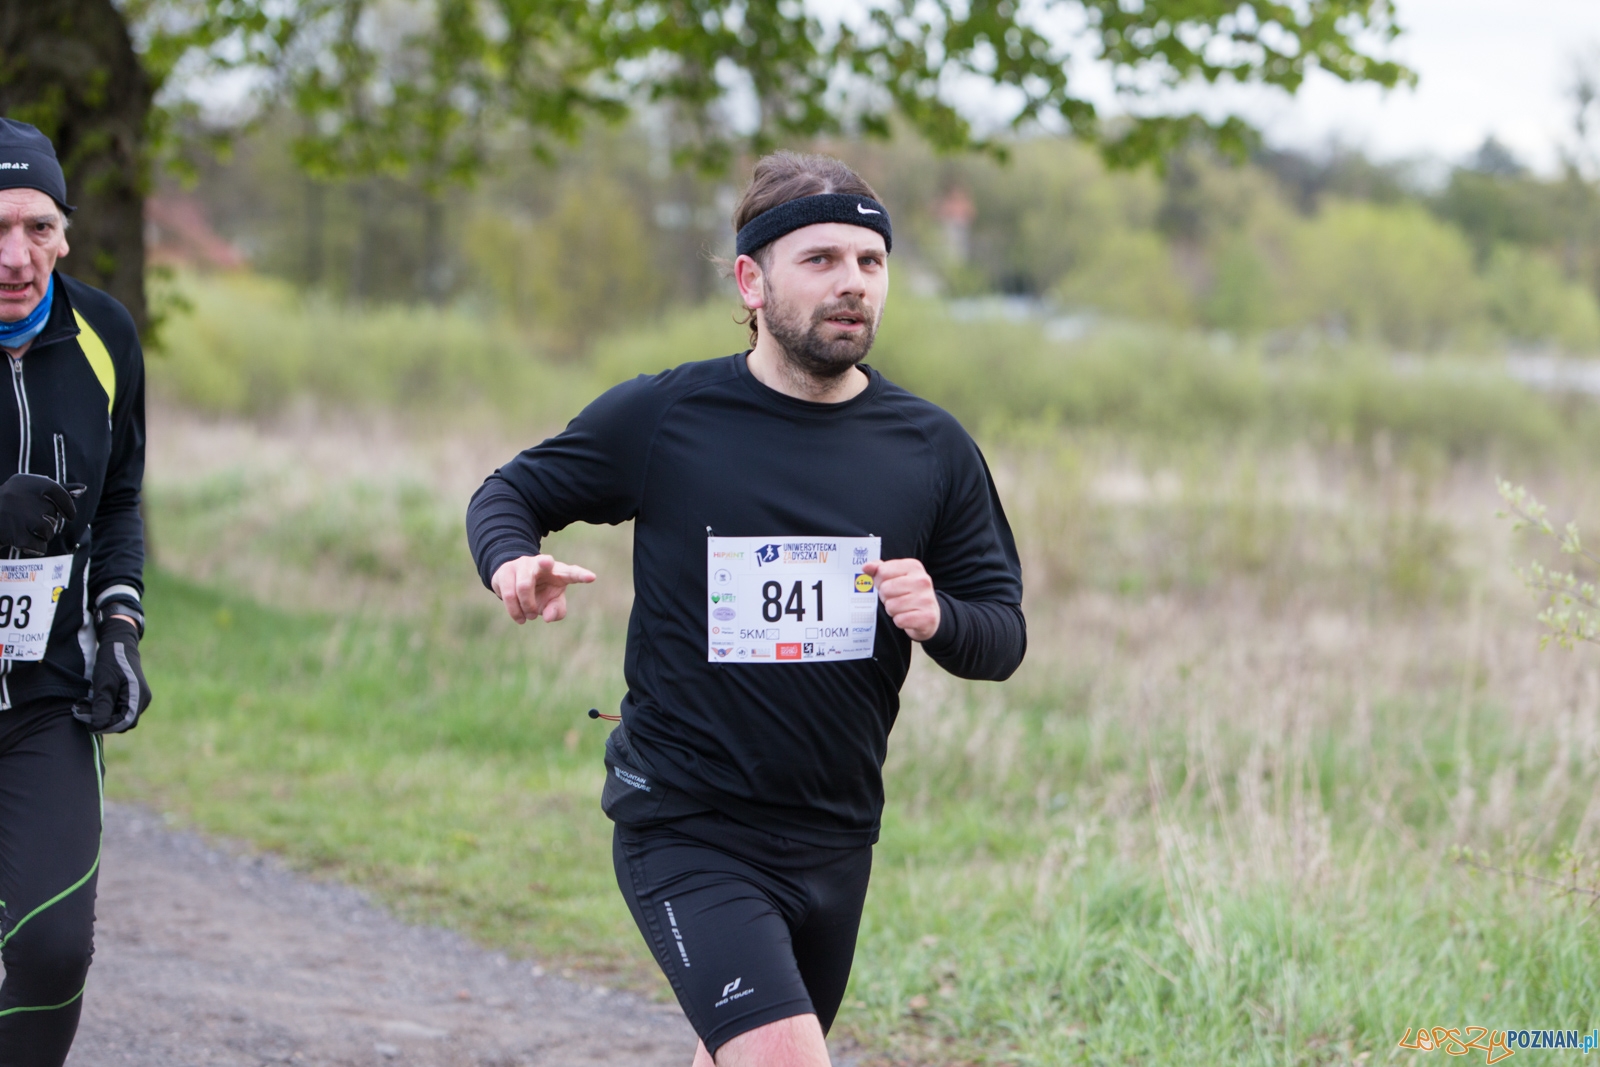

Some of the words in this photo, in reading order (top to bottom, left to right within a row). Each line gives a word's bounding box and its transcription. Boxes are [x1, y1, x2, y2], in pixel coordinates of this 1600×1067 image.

[783, 543, 837, 552] UNIWERSYTECKA
[783, 551, 818, 561] ZADYSZKA
[1, 564, 44, 572] UNIWERSYTECKA
[762, 580, 823, 623] 841
[0, 595, 32, 629] 93
[740, 629, 766, 639] 5KM
[819, 627, 849, 638] 10KM
[21, 633, 45, 643] 10KM
